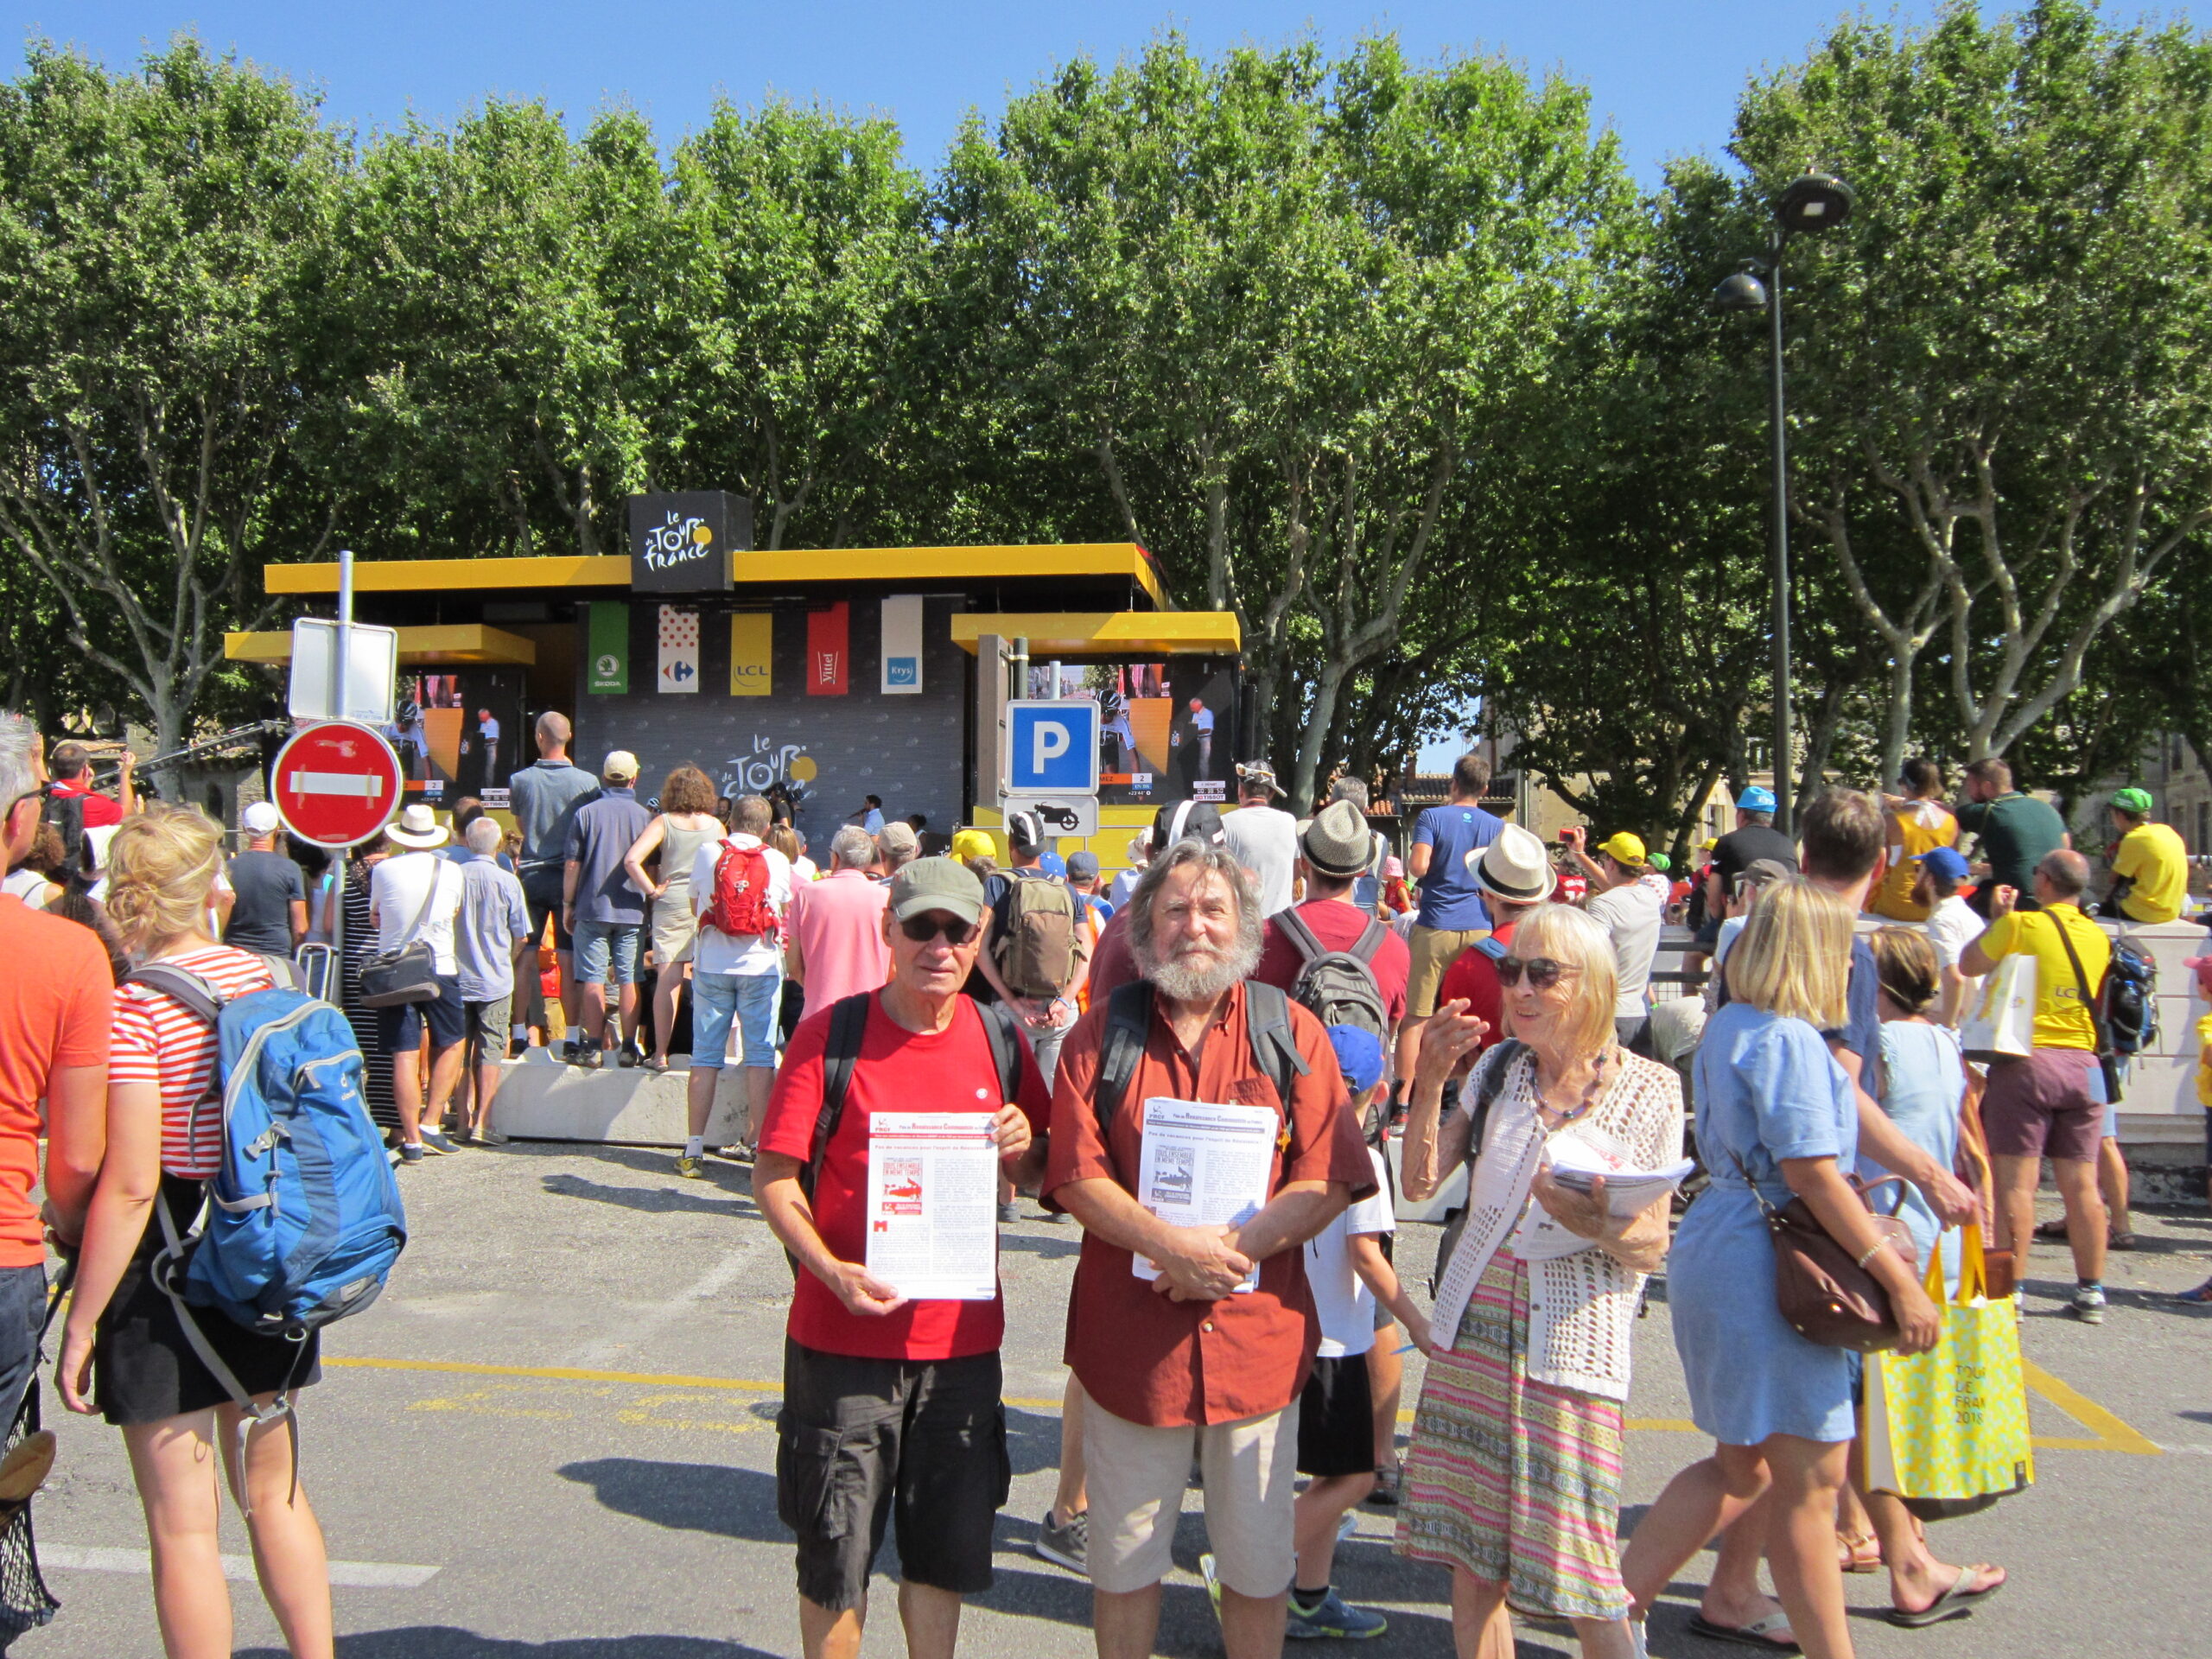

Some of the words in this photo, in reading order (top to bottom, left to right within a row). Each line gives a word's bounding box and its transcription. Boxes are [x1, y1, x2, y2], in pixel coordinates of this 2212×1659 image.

[737, 664, 768, 676] LCL
[823, 653, 833, 683] Vittel
[891, 665, 912, 677] Krys
[1033, 721, 1071, 774] P
[2055, 986, 2080, 999] LC
[1955, 1382, 1973, 1394] DE
